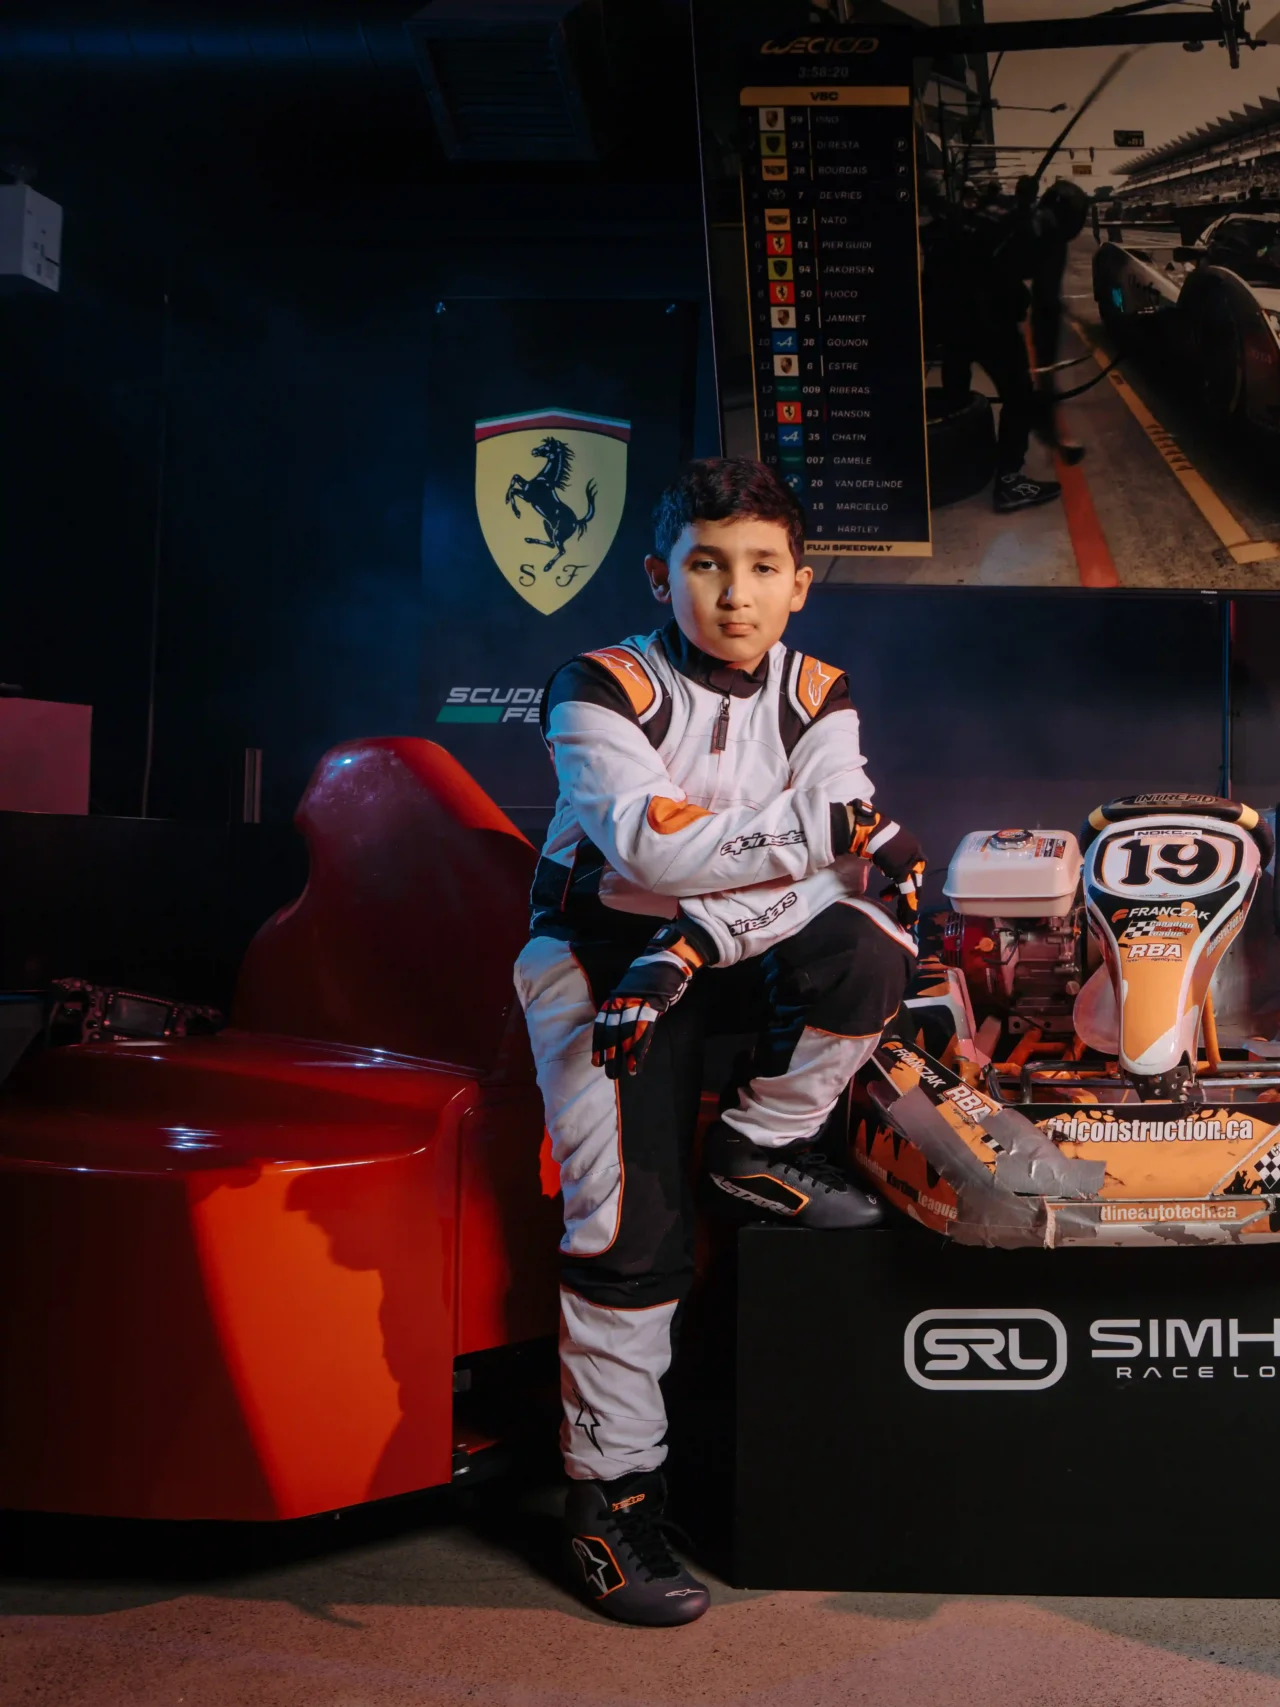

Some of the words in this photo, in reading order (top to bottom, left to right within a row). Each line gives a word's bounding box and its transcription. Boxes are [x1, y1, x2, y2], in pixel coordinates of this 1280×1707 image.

[797, 66, 849, 79] 3:58:20
[817, 165, 868, 175] BOURDAIS
[797, 191, 804, 199] 7
[834, 191, 863, 199] VRIES
[796, 216, 808, 225] 12
[820, 216, 847, 225] NATO
[821, 240, 843, 249] PIER
[845, 240, 873, 249] GUIDI
[800, 290, 813, 298] 50
[824, 290, 858, 298] FUOCO
[804, 314, 811, 322] 5
[825, 314, 867, 323] JAMINET
[826, 338, 868, 347] GOUNON
[828, 362, 859, 371] ESTRE
[829, 385, 870, 395] RIBERAS
[831, 410, 871, 418] HANSON
[808, 433, 820, 441] 35
[832, 433, 867, 441] CHATIN
[806, 456, 824, 464] 007
[833, 456, 872, 465] GAMBLE
[810, 479, 823, 487] 20
[835, 480, 855, 488] VAN
[855, 480, 875, 488] DER
[876, 480, 904, 489] LINDE
[836, 503, 889, 511] MARCIELLO
[837, 525, 880, 533] HARTLEY
[832, 544, 892, 552] SPEEDWAY
[518, 564, 536, 587] S
[555, 564, 590, 587] F
[1133, 792, 1217, 804] INTREPID
[1118, 837, 1220, 886] 19
[1128, 906, 1211, 921] FRANCZAK
[1128, 943, 1183, 958] RBA
[892, 1048, 947, 1089] FRANCZAK
[943, 1083, 993, 1124] RBA
[924, 1327, 1049, 1371] SRL
[1116, 1366, 1215, 1379] RACE
